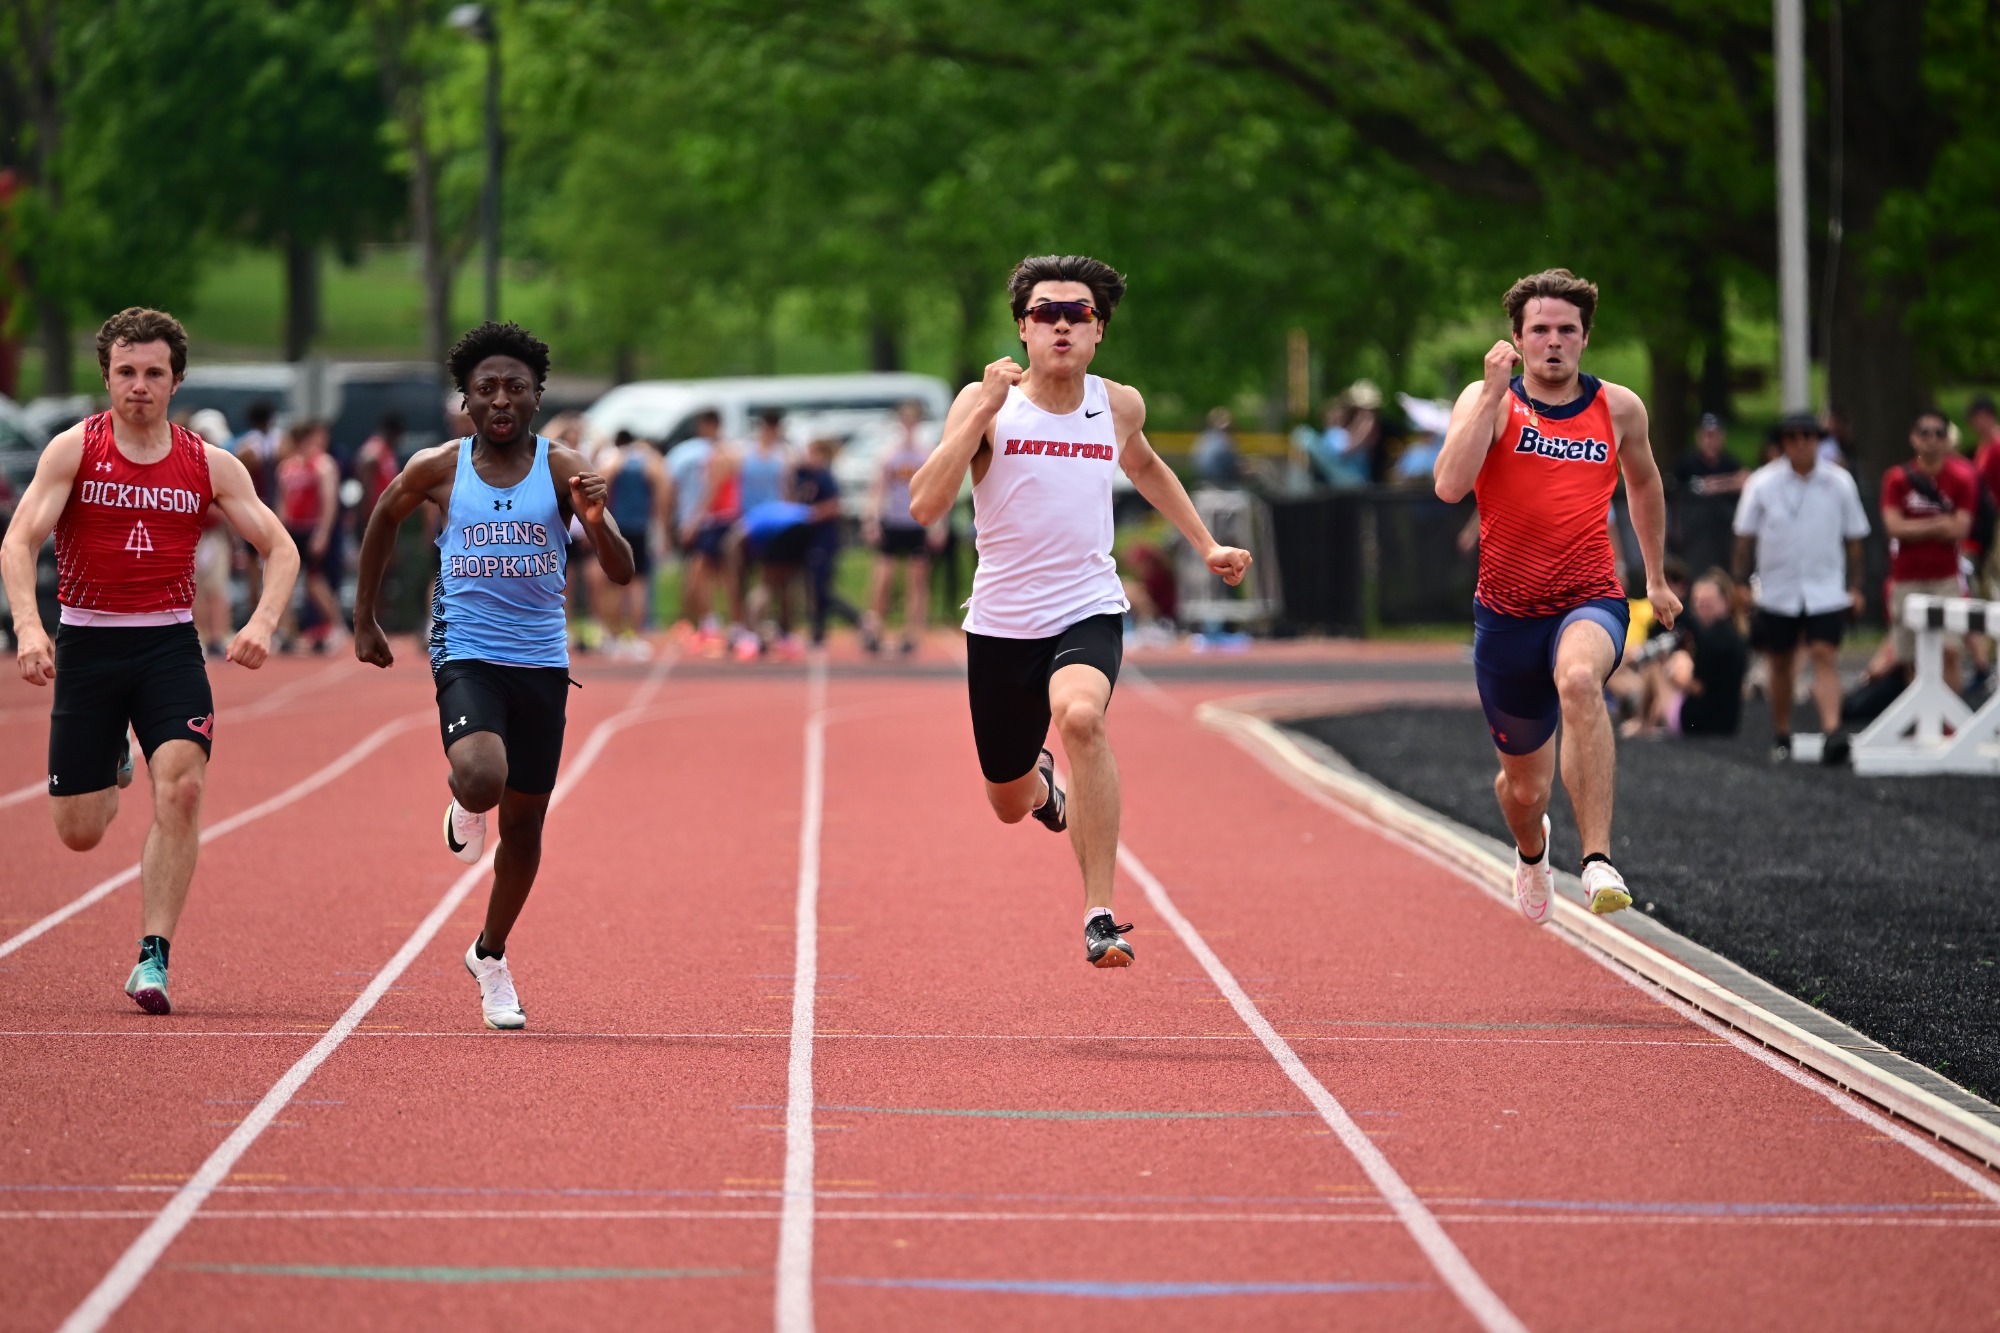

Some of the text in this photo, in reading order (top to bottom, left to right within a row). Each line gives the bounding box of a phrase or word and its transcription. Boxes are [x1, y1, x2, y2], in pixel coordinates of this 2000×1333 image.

[1004, 439, 1114, 461] HAVERFORD
[1514, 426, 1608, 463] Bullets
[81, 480, 201, 514] DICKINSON
[462, 521, 548, 550] JOHNS
[450, 549, 559, 578] HOPKINS
